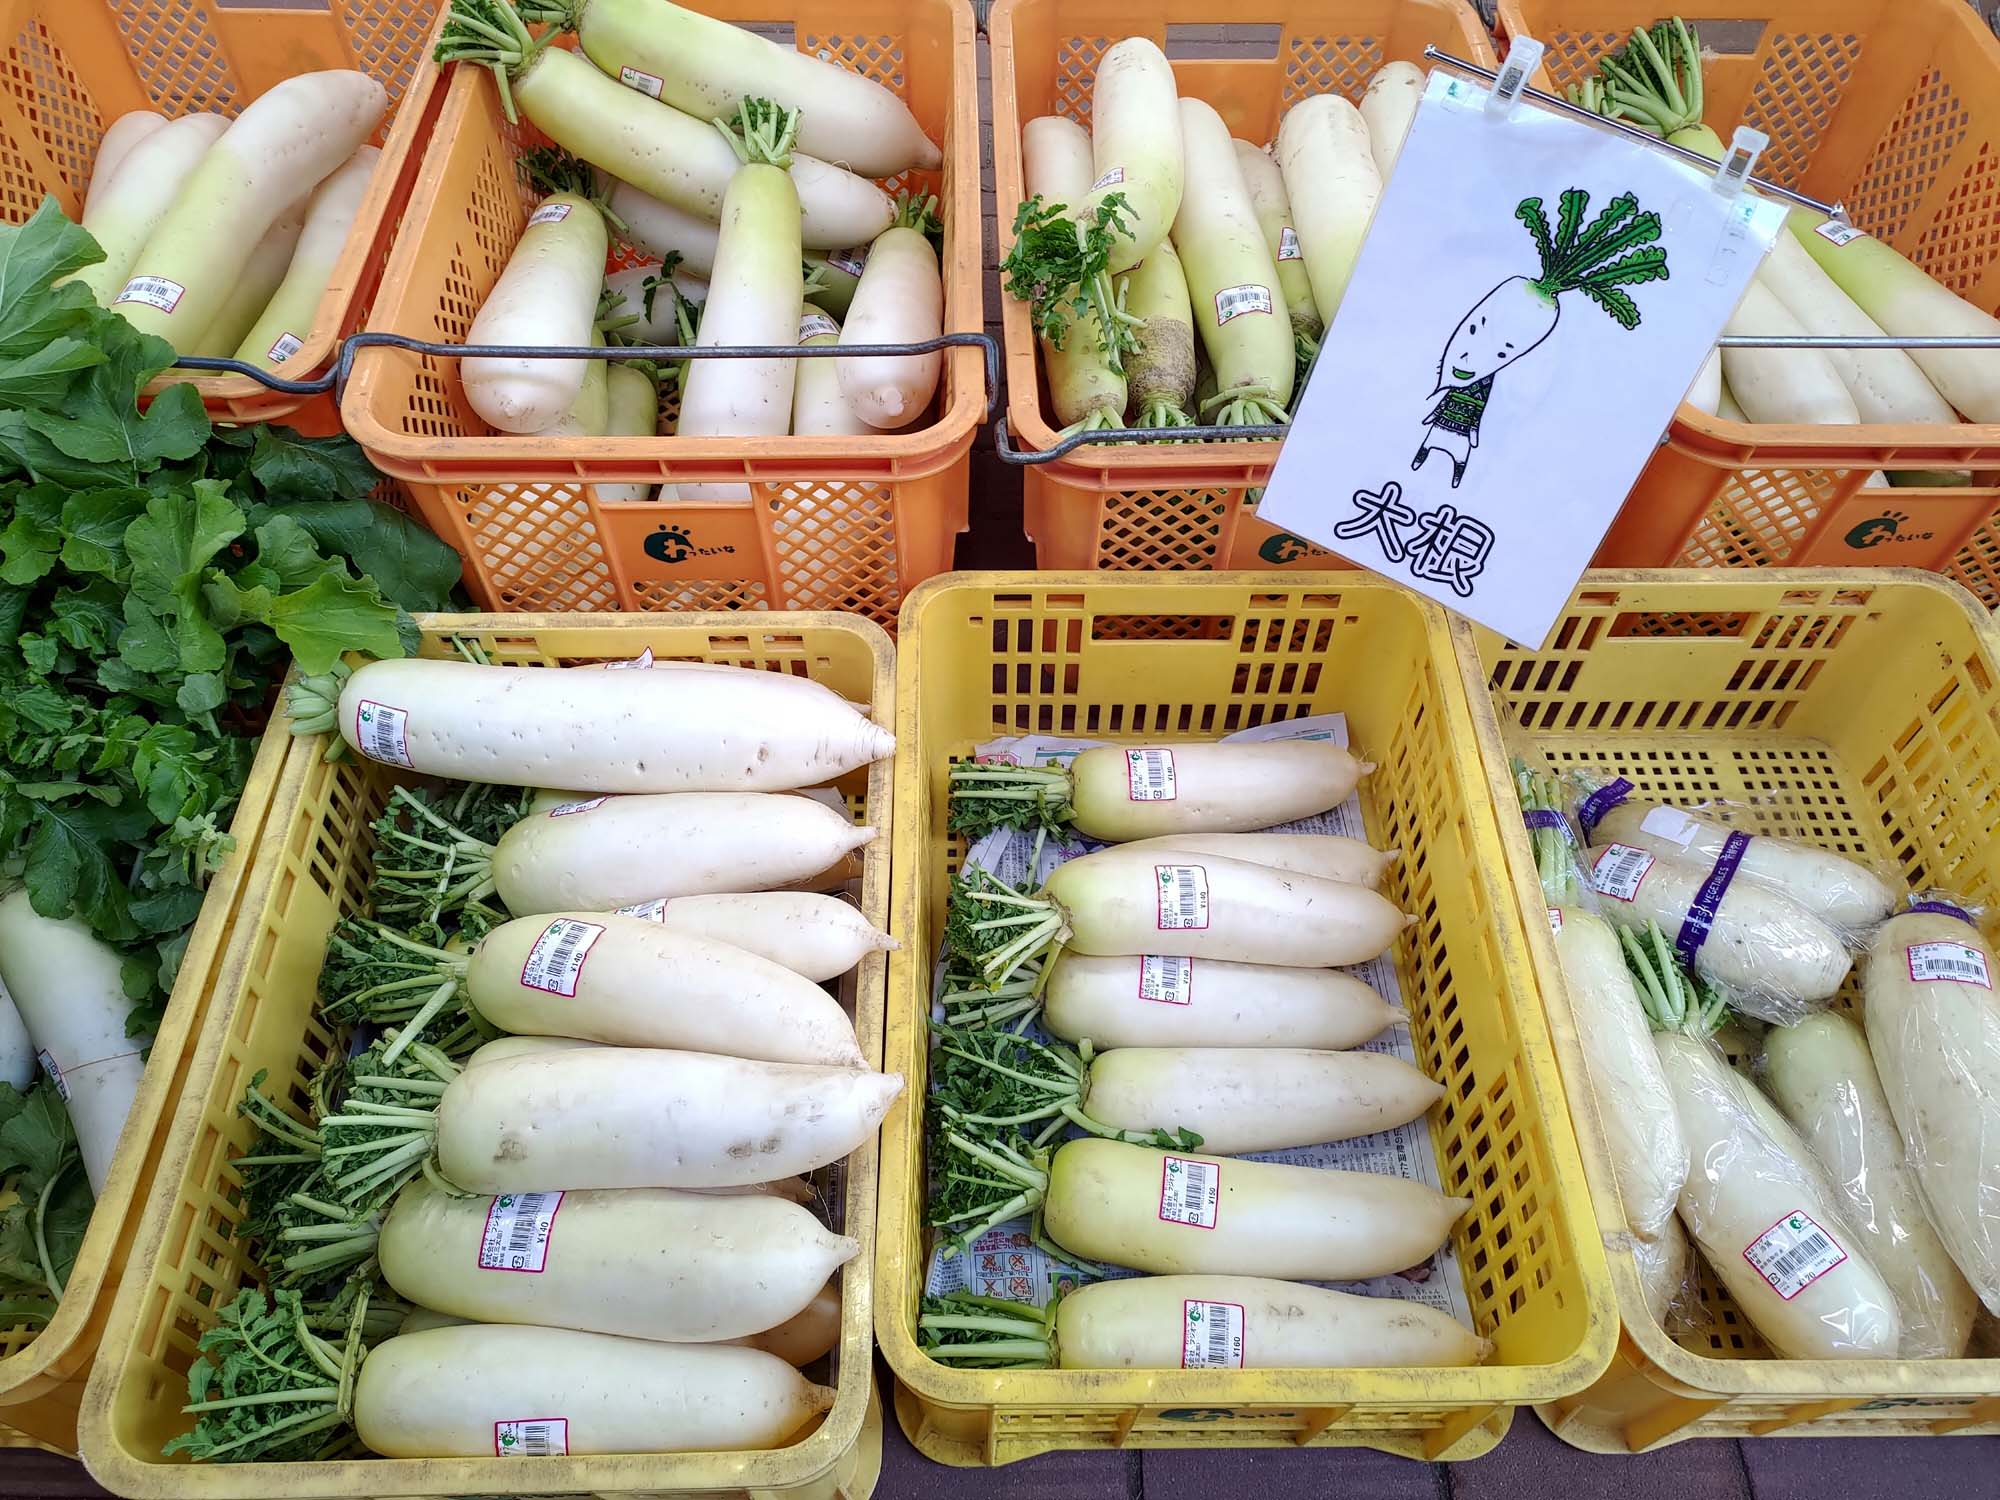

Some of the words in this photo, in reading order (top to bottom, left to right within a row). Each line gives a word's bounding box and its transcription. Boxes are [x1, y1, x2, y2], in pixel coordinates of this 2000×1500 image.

[1334, 481, 1495, 597] 大根
[570, 952, 584, 972] ¥140
[537, 1222, 549, 1244] ¥140
[1233, 1336, 1241, 1358] ¥160
